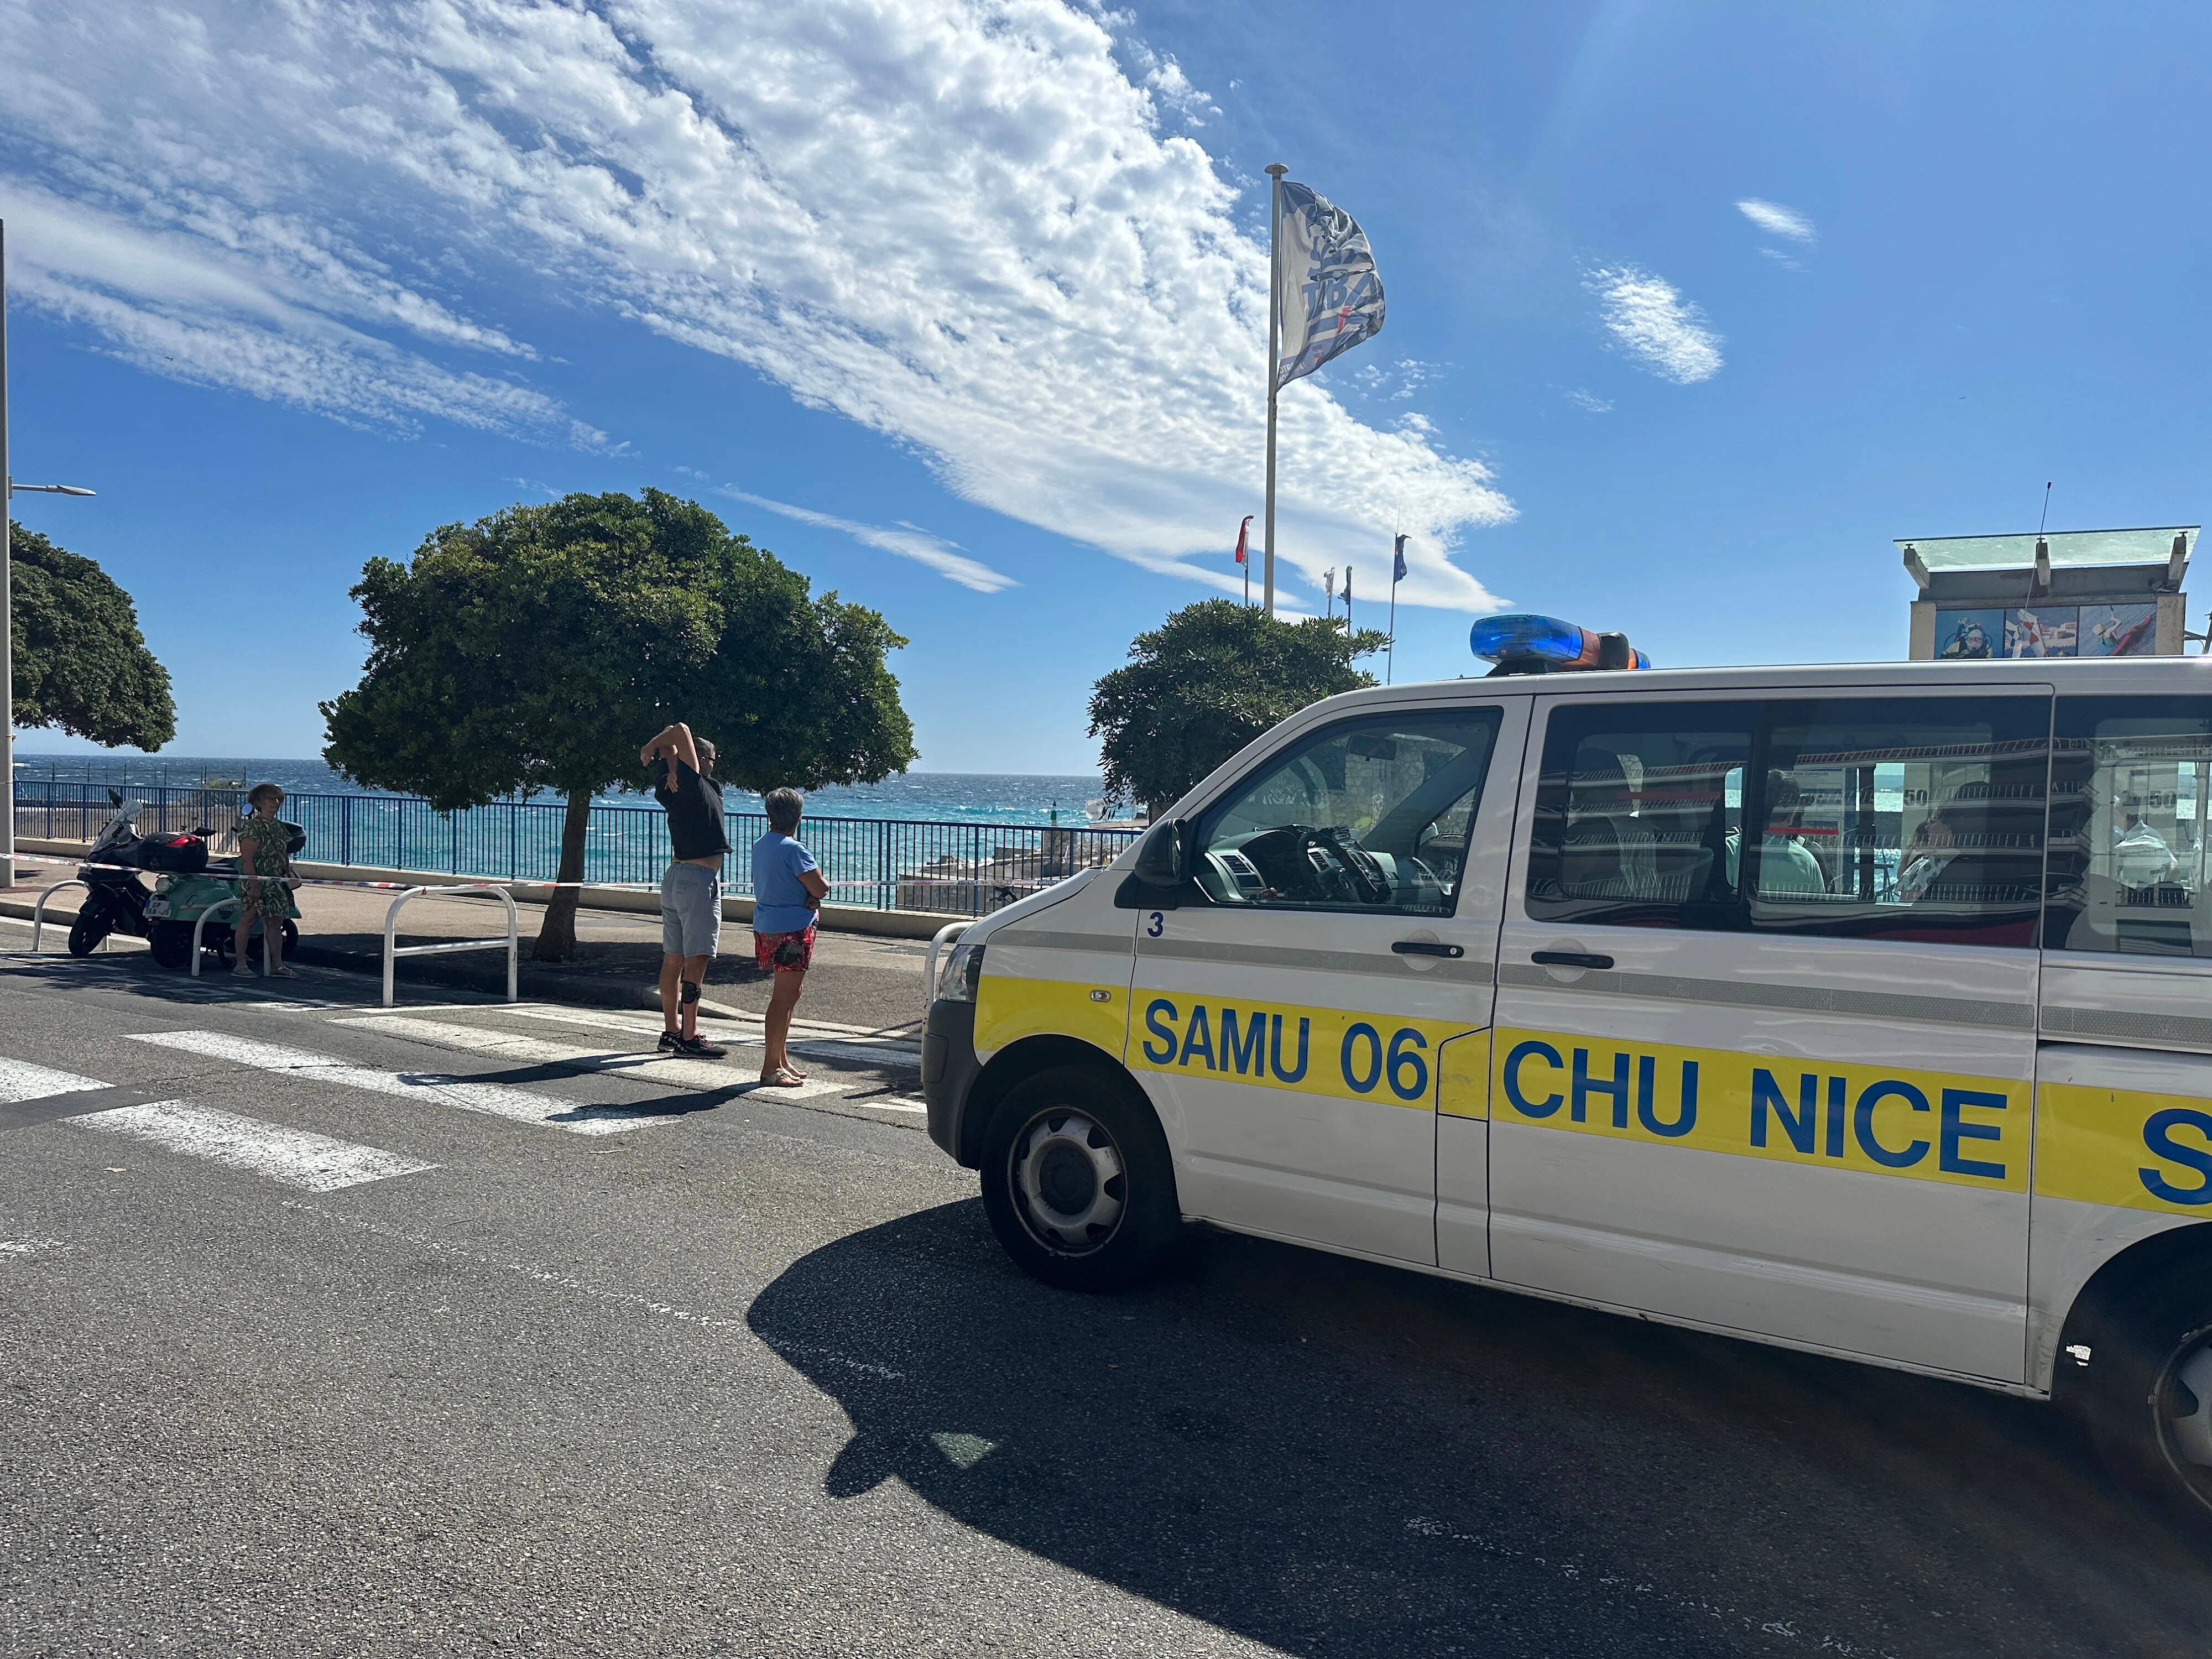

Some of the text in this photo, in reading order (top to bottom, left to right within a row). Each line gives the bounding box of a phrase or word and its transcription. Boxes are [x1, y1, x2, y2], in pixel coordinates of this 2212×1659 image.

[1302, 273, 1379, 321] TABA
[1147, 912, 1164, 937] 3
[1143, 999, 1427, 1100] SAMU 06
[1503, 1041, 2006, 1179] CHU NICE
